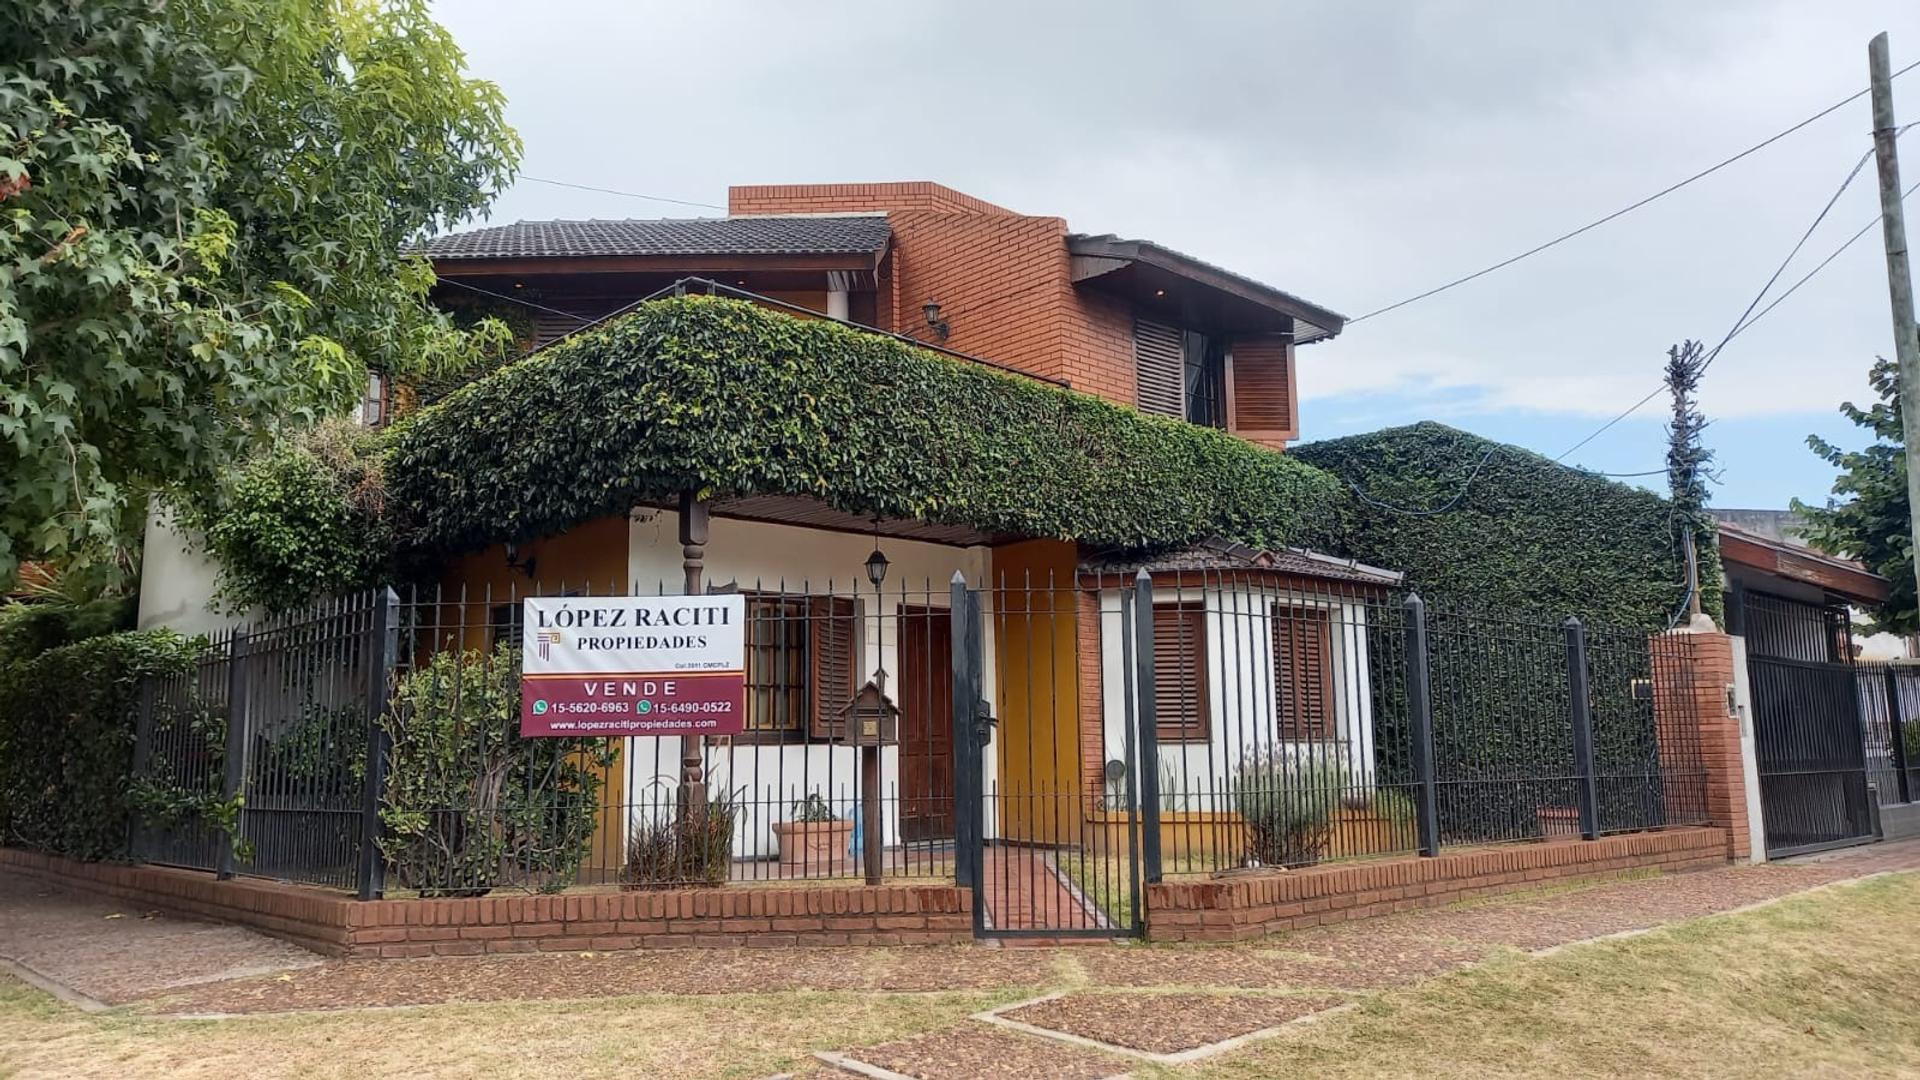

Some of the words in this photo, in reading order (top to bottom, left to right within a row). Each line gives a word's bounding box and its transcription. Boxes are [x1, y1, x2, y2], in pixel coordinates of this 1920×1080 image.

[538, 604, 627, 628] LÓPEZ
[635, 607, 730, 627] RACITI
[577, 635, 707, 650] PROPIEDADES
[584, 682, 677, 696] VENDE
[552, 702, 629, 713] 15-5620-6963
[654, 702, 731, 713] 15-6490-0522
[550, 719, 717, 731] www.lopezracitipropiedades.com
